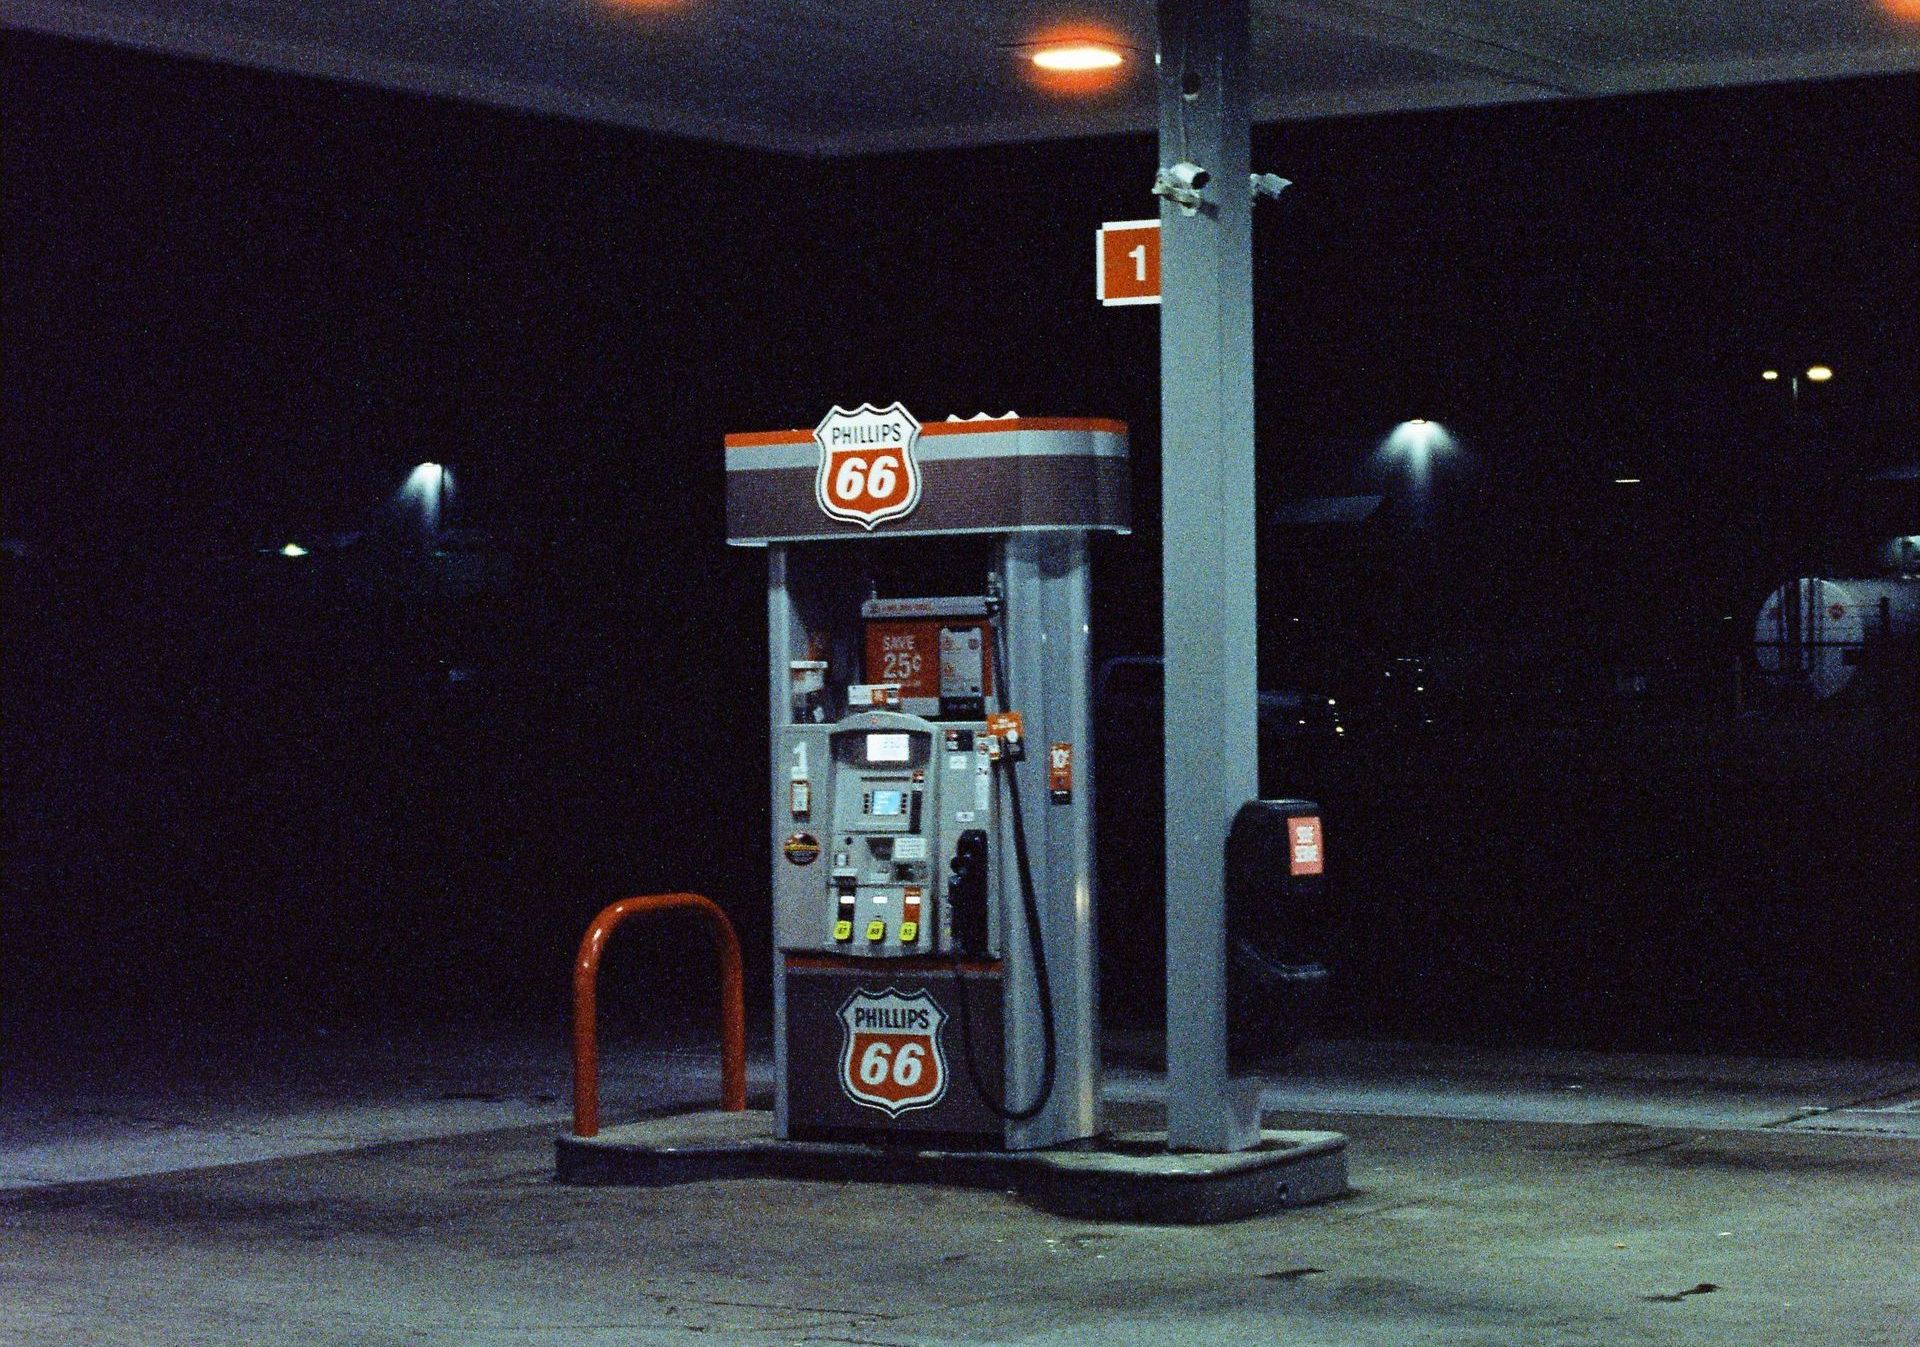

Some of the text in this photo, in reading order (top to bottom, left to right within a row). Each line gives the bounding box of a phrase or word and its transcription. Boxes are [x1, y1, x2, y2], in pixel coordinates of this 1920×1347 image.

[1128, 244, 1146, 282] 1
[831, 423, 902, 446] PHILLIPS
[835, 455, 899, 502] 66
[855, 1007, 929, 1030] PHILLIPS
[860, 1042, 926, 1087] 66
